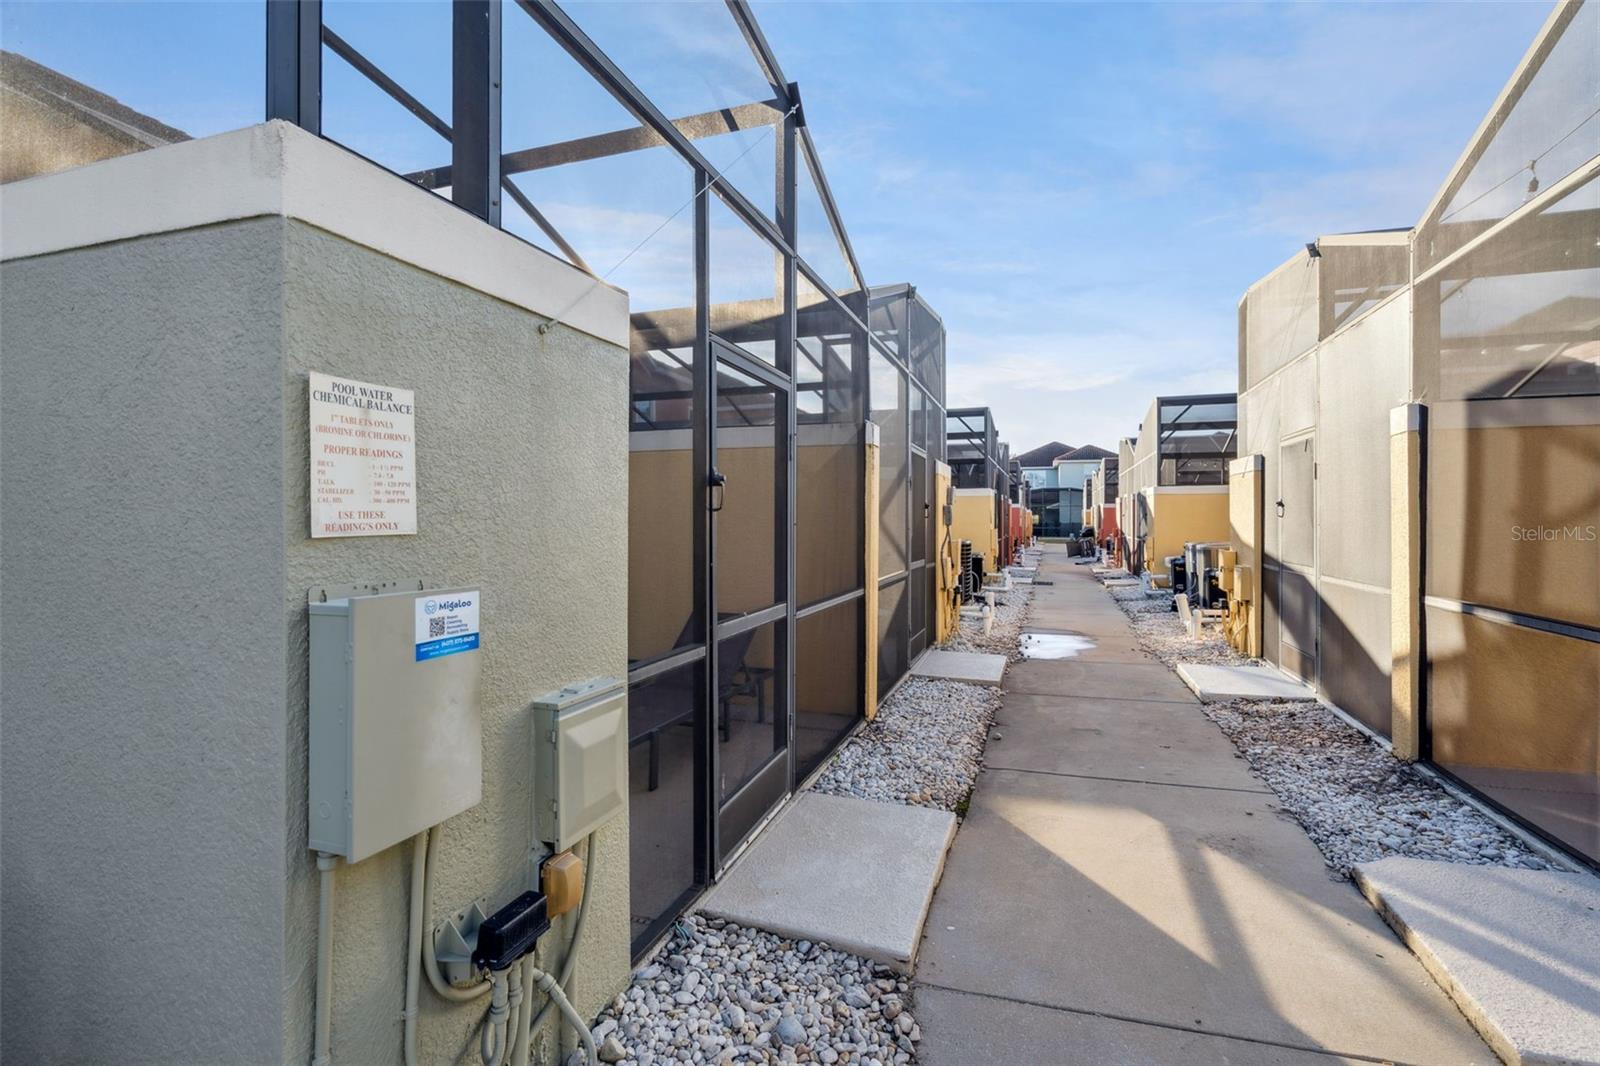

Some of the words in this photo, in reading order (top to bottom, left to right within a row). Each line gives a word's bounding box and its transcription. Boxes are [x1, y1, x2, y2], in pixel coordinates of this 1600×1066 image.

[332, 382, 358, 397] POOL
[359, 387, 393, 402] WATER
[313, 390, 365, 409] CHEMICAL
[367, 399, 413, 415] BALANCE
[340, 415, 374, 427] TABLETS
[374, 420, 394, 429] ONLY
[315, 424, 353, 437] (BROMINE
[355, 429, 366, 438] OR
[367, 430, 411, 443] CHLORINE)
[324, 444, 359, 457] PROPER
[359, 447, 404, 459] READINGS
[337, 511, 354, 519] USE
[357, 511, 386, 519] THESE
[375, 522, 399, 530] ONLY
[439, 600, 472, 611] Migaloo
